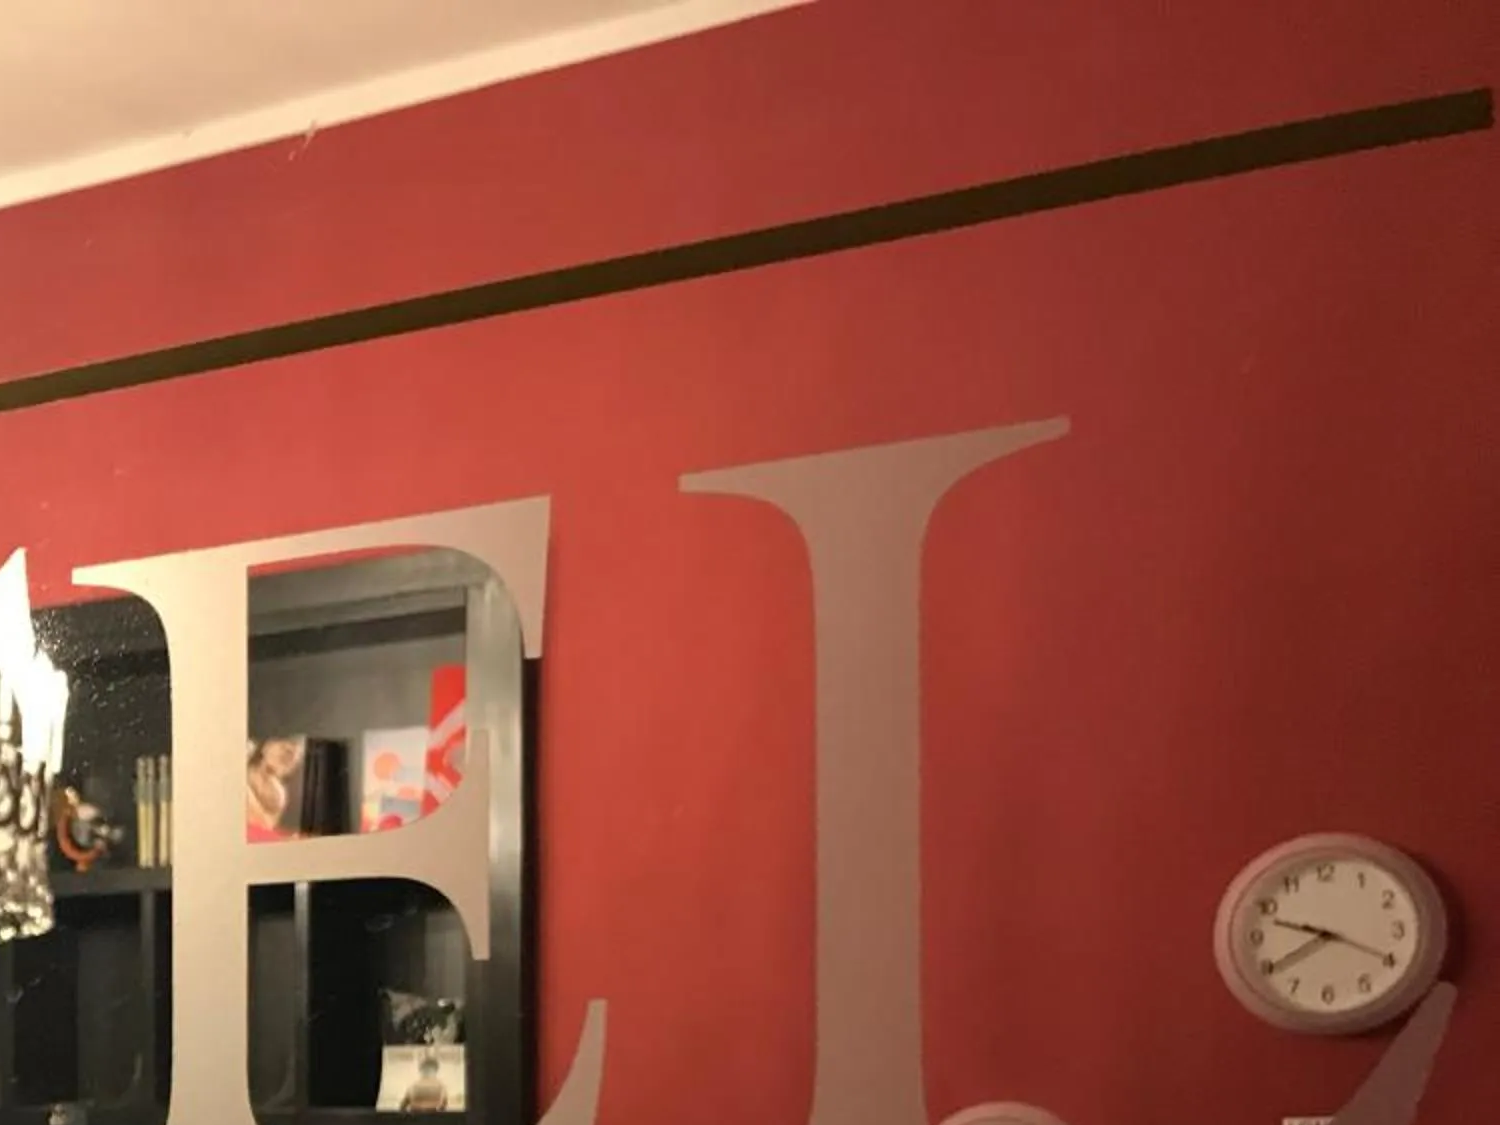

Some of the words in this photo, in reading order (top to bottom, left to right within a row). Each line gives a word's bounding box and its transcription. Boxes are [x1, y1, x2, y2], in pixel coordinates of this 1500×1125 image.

[1316, 863, 1336, 882] 12
[1357, 872, 1366, 889] 1
[1283, 875, 1300, 894] 11
[1258, 898, 1279, 916] 10
[1381, 889, 1396, 909] 2
[1391, 920, 1405, 940] 3
[1288, 976, 1301, 994] 7
[1321, 985, 1335, 1005] 6
